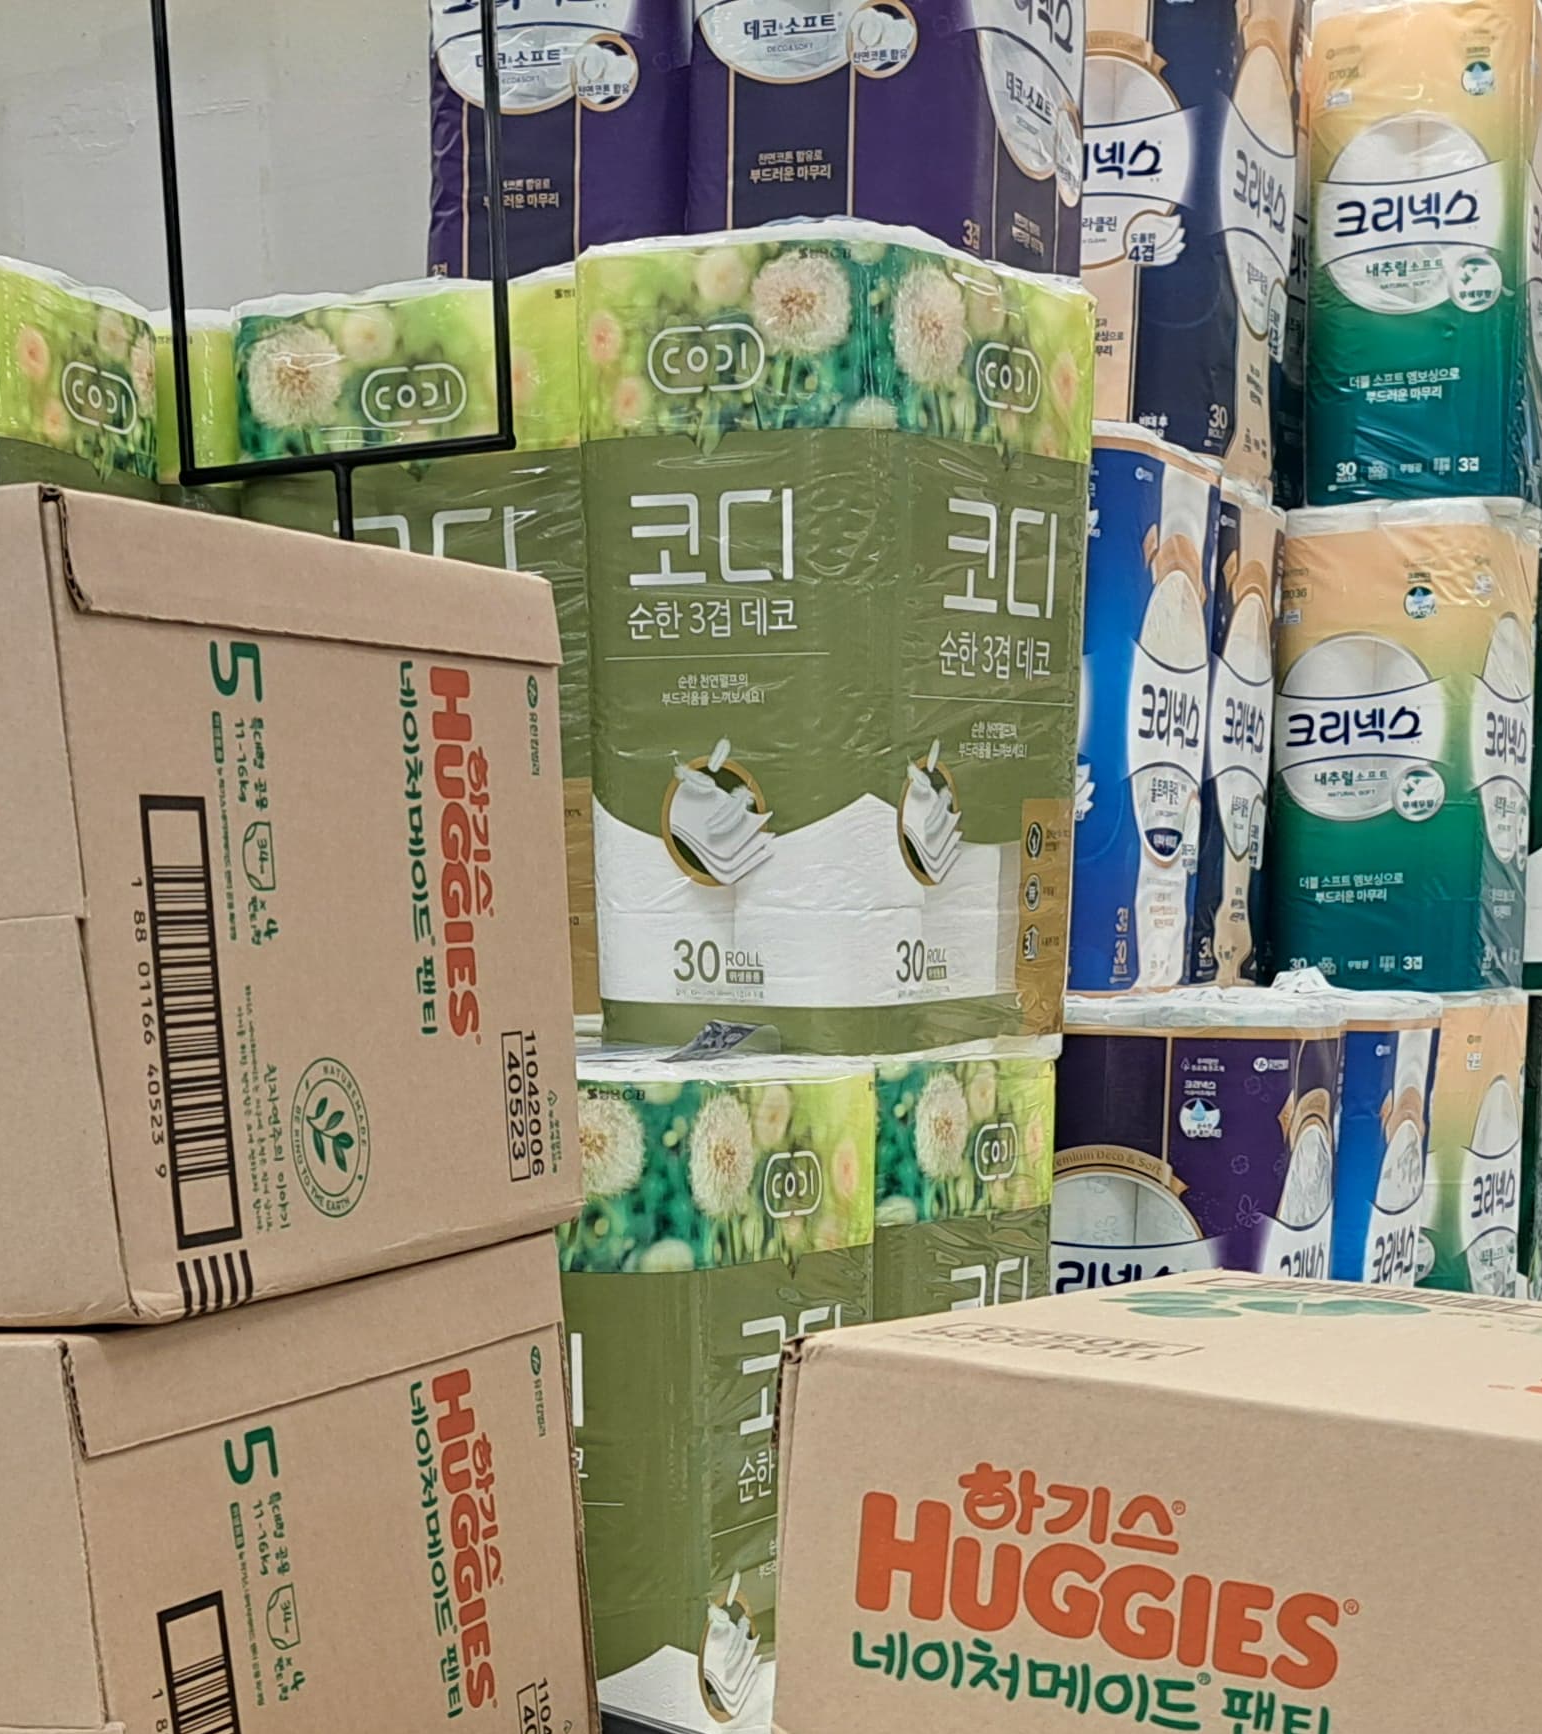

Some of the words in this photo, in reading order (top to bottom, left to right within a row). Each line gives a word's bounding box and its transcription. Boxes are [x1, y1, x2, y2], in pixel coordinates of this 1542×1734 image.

[749, 165, 796, 184] 부드러운
[797, 163, 832, 182] 마무리
[1333, 188, 1482, 239] 크리넥스
[1127, 243, 1156, 263] 4겹
[1207, 404, 1228, 429] 30
[1335, 461, 1358, 478] 30
[1457, 456, 1481, 474] 3겹
[628, 487, 795, 588] 코디
[942, 496, 1059, 620] 코디
[626, 600, 684, 641] 순한
[689, 599, 732, 638] 3겹
[739, 597, 799, 638] 데코
[210, 640, 263, 703] 5
[938, 631, 979, 679] 순한
[981, 634, 1012, 678] 3겹
[1015, 639, 1052, 681] 데코
[1139, 684, 1201, 750] 크리넥스
[1223, 695, 1266, 755] 크리넥스
[1285, 704, 1424, 749] 크리넥스
[397, 659, 437, 946] 네이처메이드
[468, 745, 495, 917] 하기스
[428, 664, 482, 1041] HUGGIES
[133, 911, 149, 945] 88
[672, 938, 721, 984] 30
[725, 948, 765, 969] ROLL
[895, 939, 925, 984] 30
[926, 947, 948, 965] ROLL
[1402, 954, 1425, 971] 3겹
[136, 962, 156, 1047] 01166
[414, 954, 439, 1037] 팬티
[146, 1063, 165, 1148] 40523
[505, 1048, 528, 1161] 40523
[523, 1029, 545, 1178] 11042006
[1472, 1168, 1517, 1220] 크리넥스
[224, 1426, 280, 1486] 5
[431, 1368, 499, 1709] HUGGIES
[471, 1432, 504, 1590] 하기스
[959, 1461, 1180, 1555] 하기스
[408, 1380, 460, 1638] 네이처메이드
[438, 1643, 464, 1720] 팬티
[854, 1490, 1340, 1690] HUGGIES
[851, 1630, 1202, 1731] 네이처메이드
